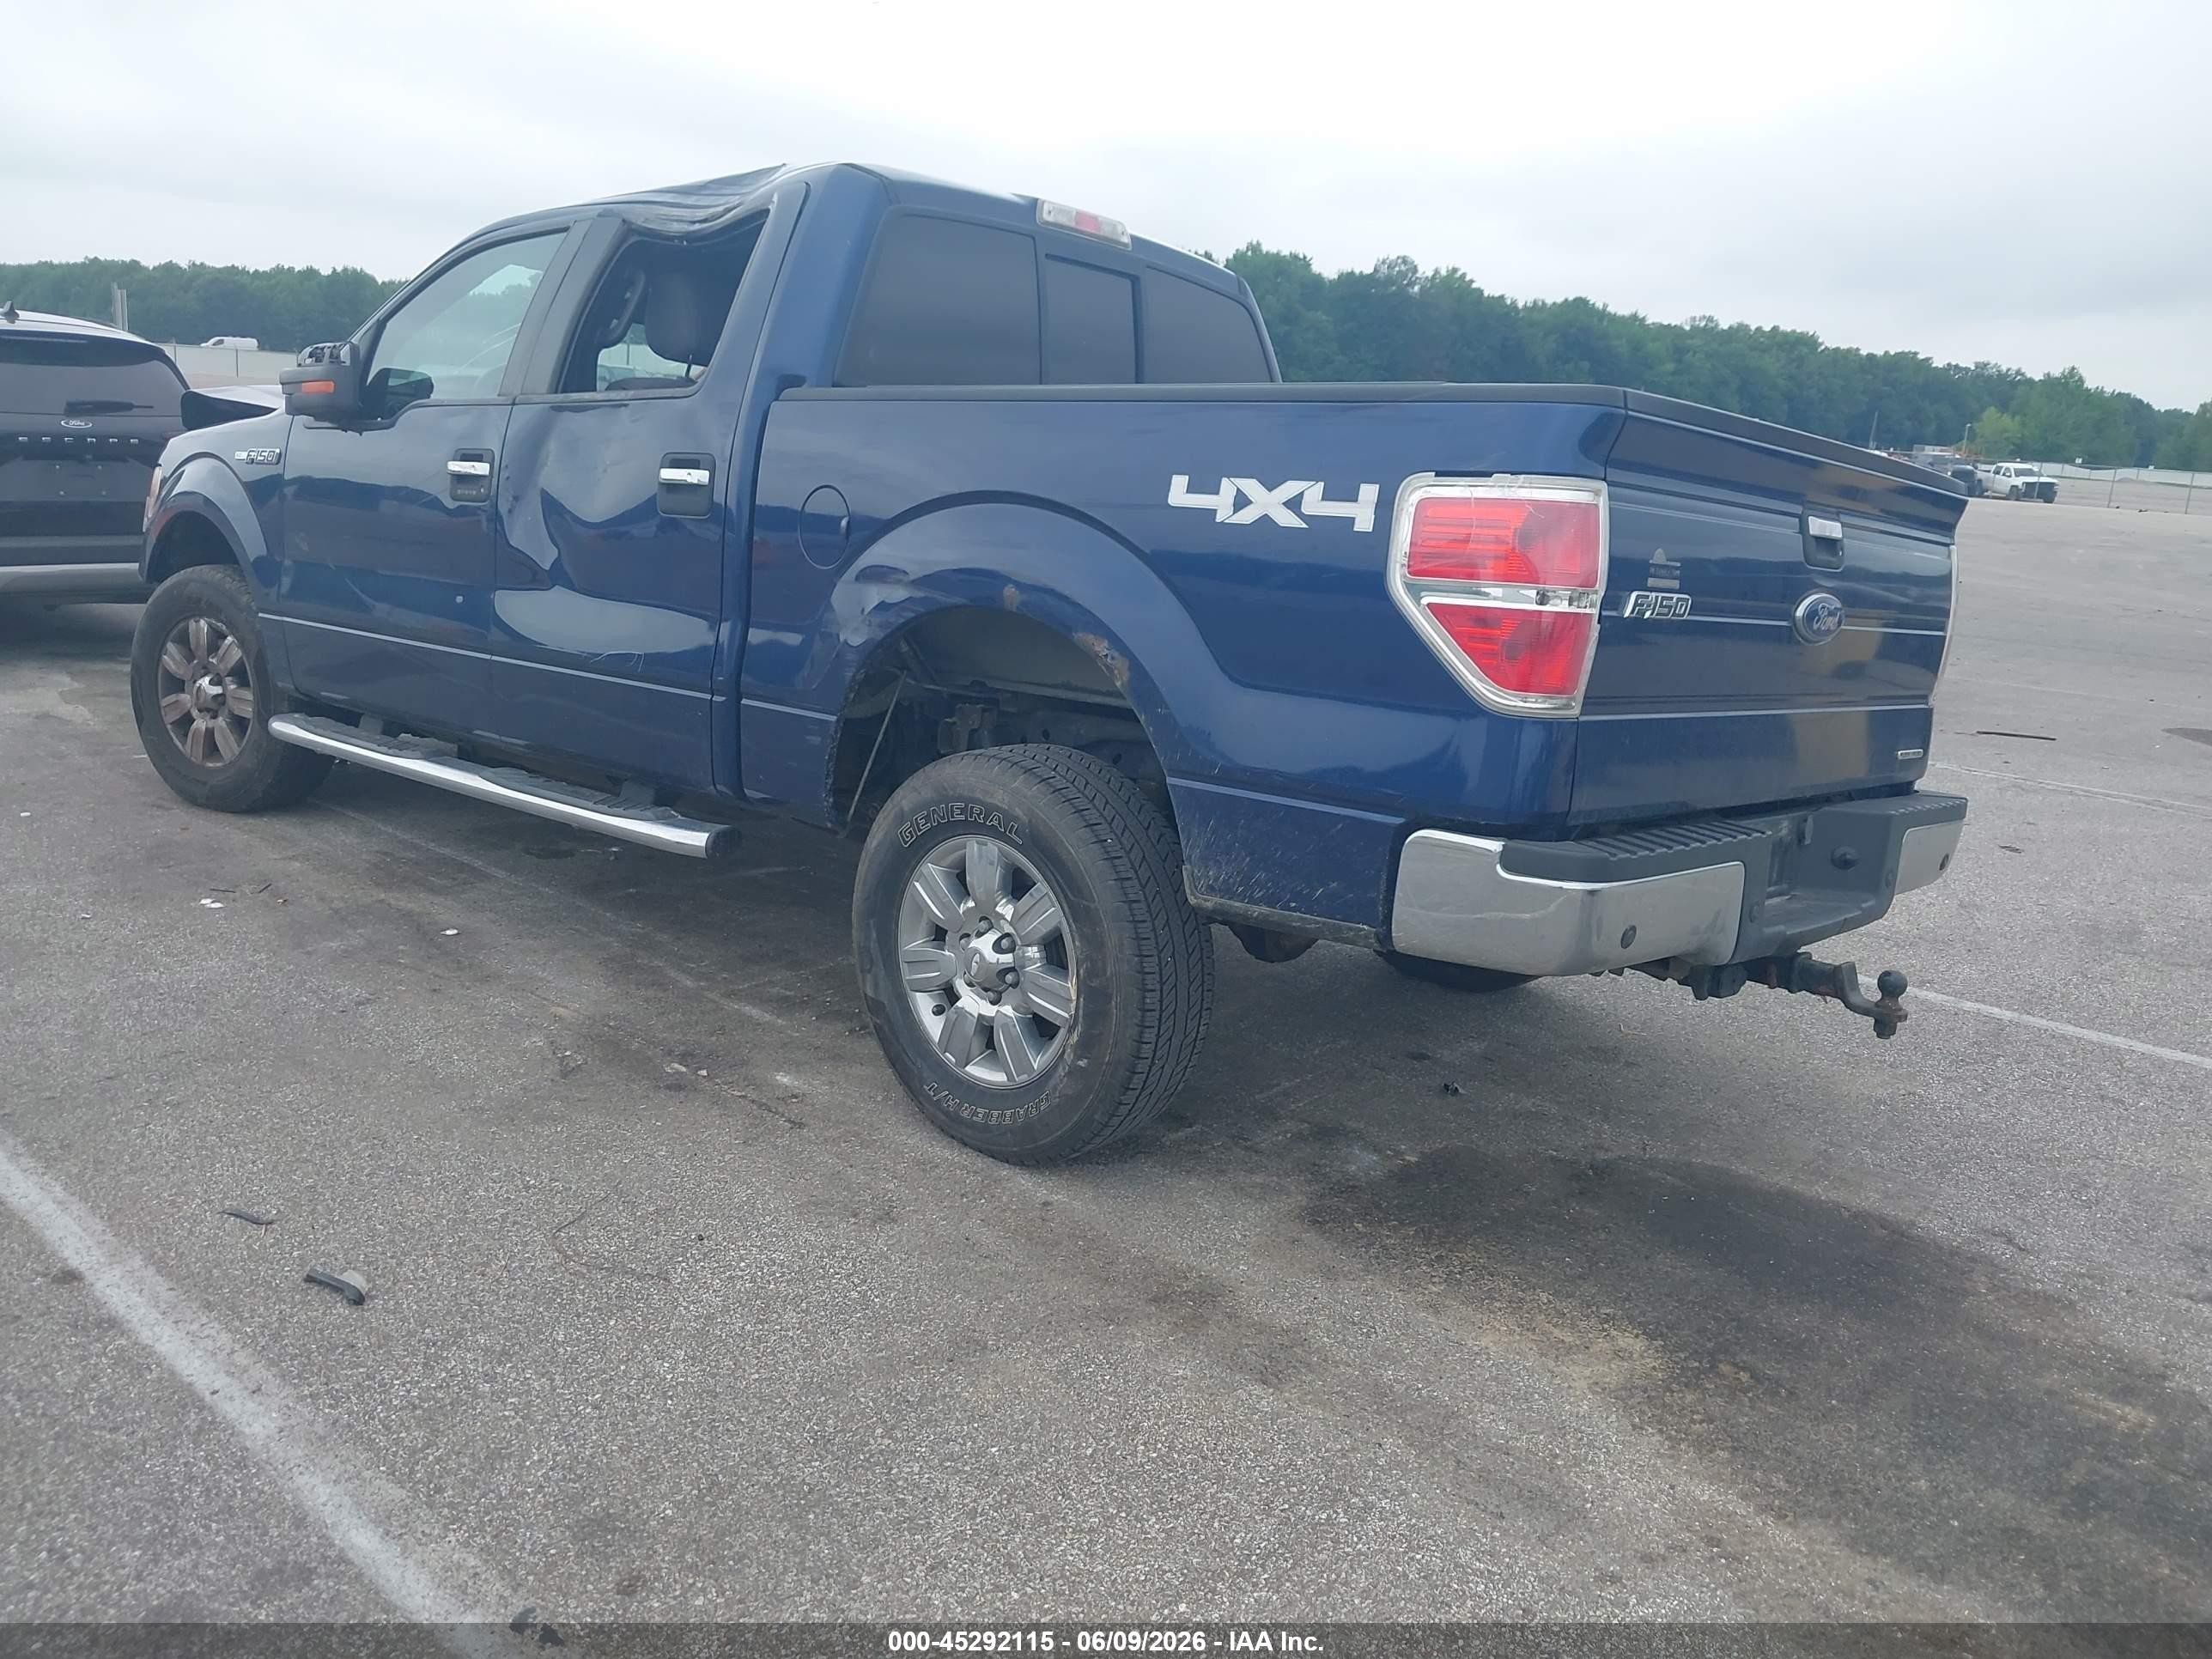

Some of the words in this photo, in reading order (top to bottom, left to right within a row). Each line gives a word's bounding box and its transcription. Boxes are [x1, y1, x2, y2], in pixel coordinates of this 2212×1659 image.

[897, 802, 1024, 848] GENERAL
[922, 1081, 960, 1111] H/T
[959, 1090, 1052, 1125] GRABBER
